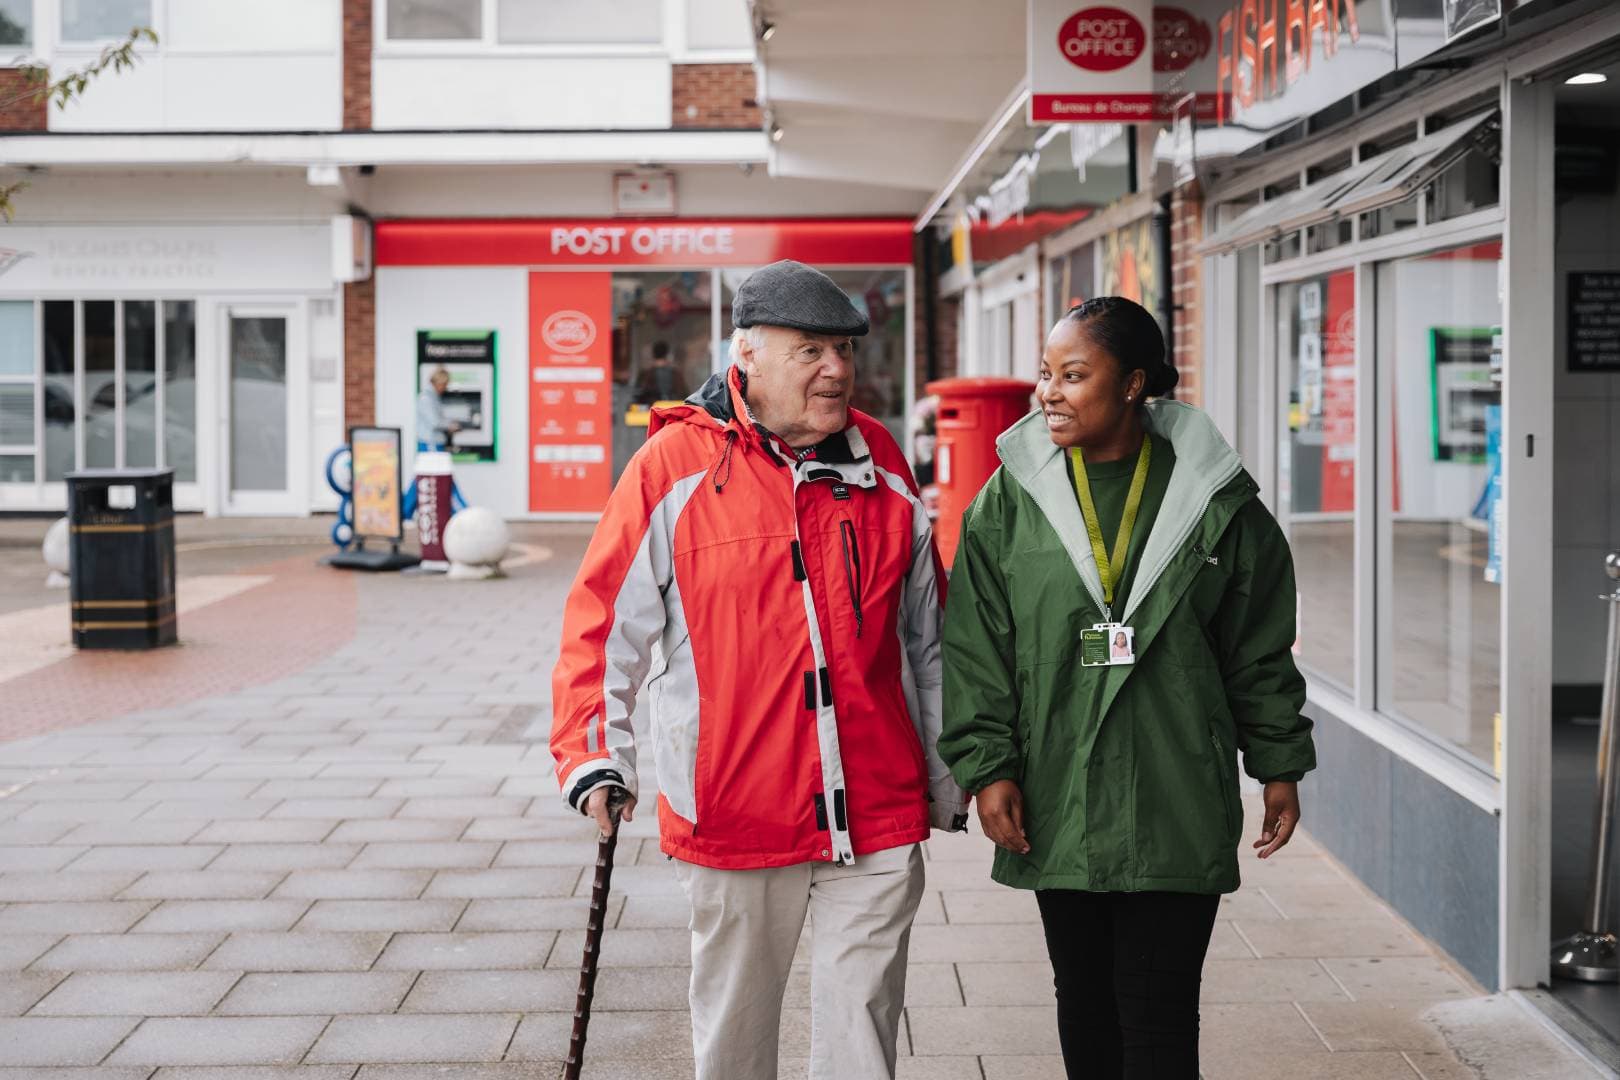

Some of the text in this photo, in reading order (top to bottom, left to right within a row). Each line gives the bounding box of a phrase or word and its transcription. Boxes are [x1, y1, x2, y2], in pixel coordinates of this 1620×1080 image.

[1077, 19, 1129, 38] POST
[1064, 37, 1136, 57] OFFICE
[1051, 100, 1092, 114] Bureau
[1095, 100, 1108, 114] de
[551, 227, 735, 255] POST OFFICE
[418, 477, 431, 545] COSTA
